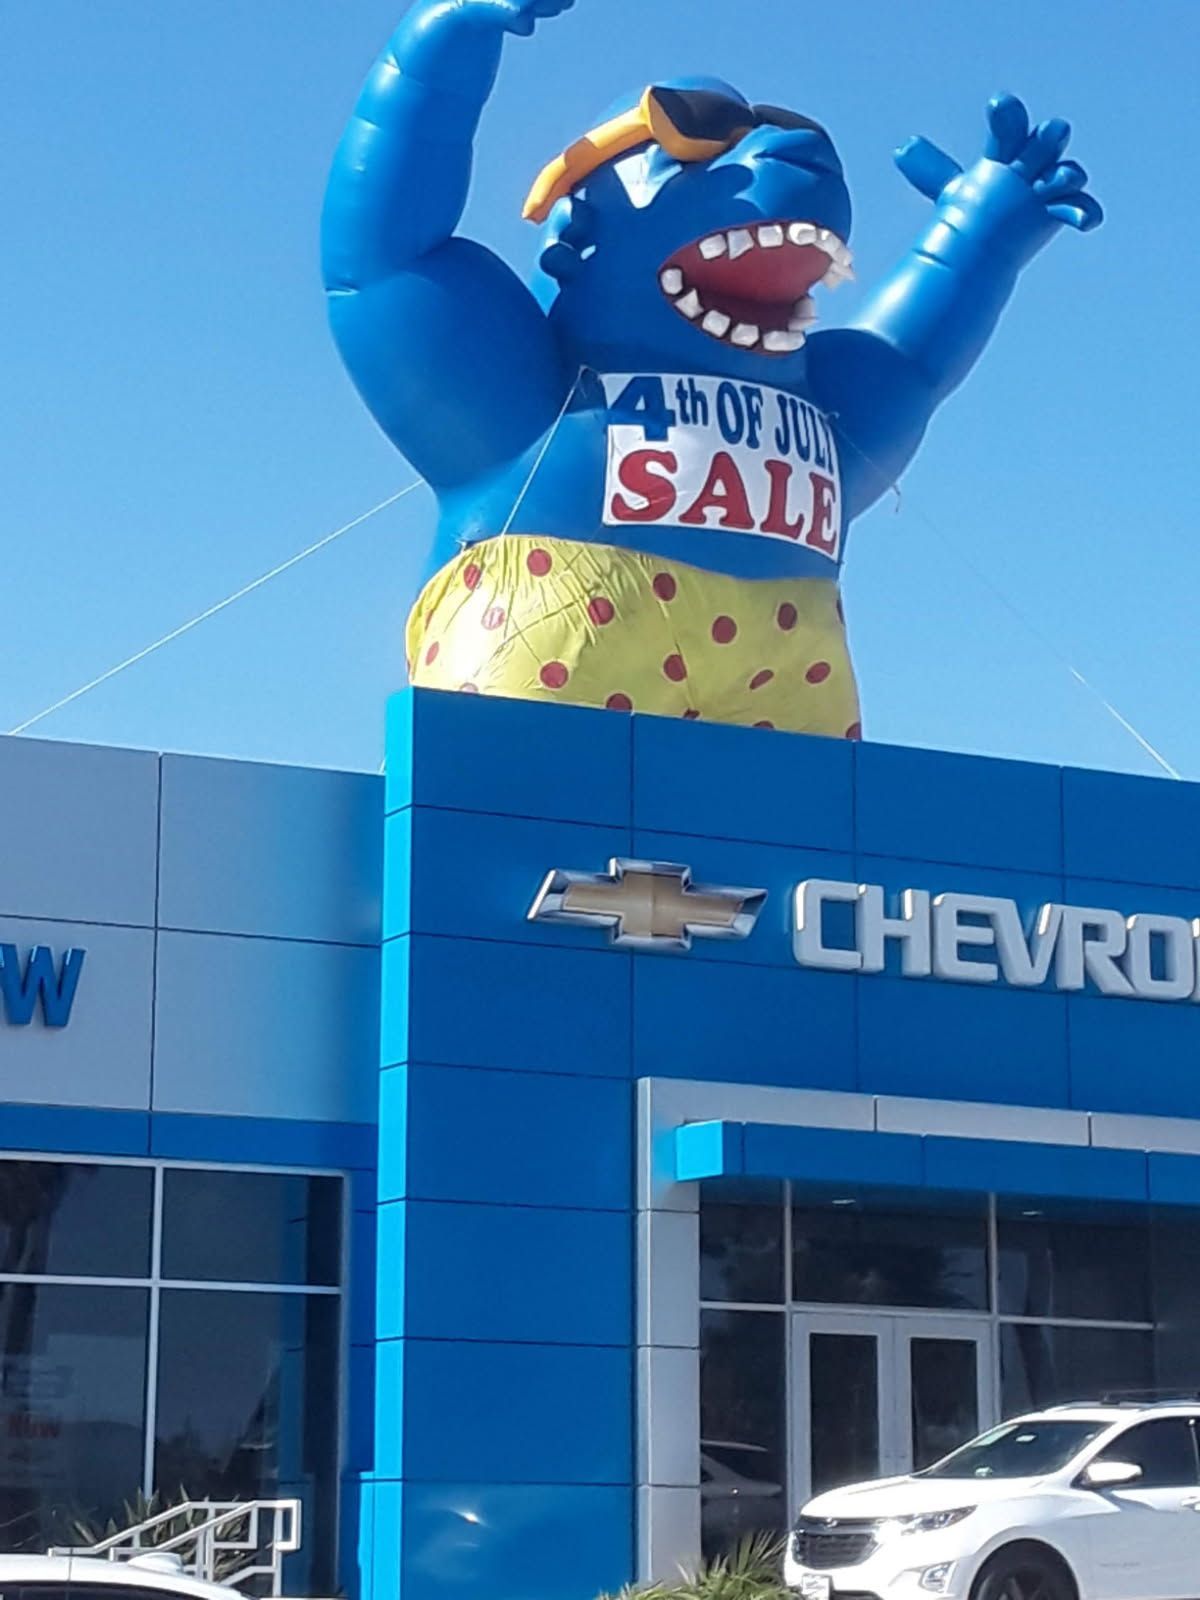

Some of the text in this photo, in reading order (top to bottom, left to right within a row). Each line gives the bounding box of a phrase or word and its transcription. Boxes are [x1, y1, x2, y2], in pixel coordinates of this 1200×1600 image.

[606, 376, 708, 442] 4th
[716, 381, 763, 449] OF
[611, 449, 837, 555] SALE
[793, 878, 1200, 1003] CHEVRO
